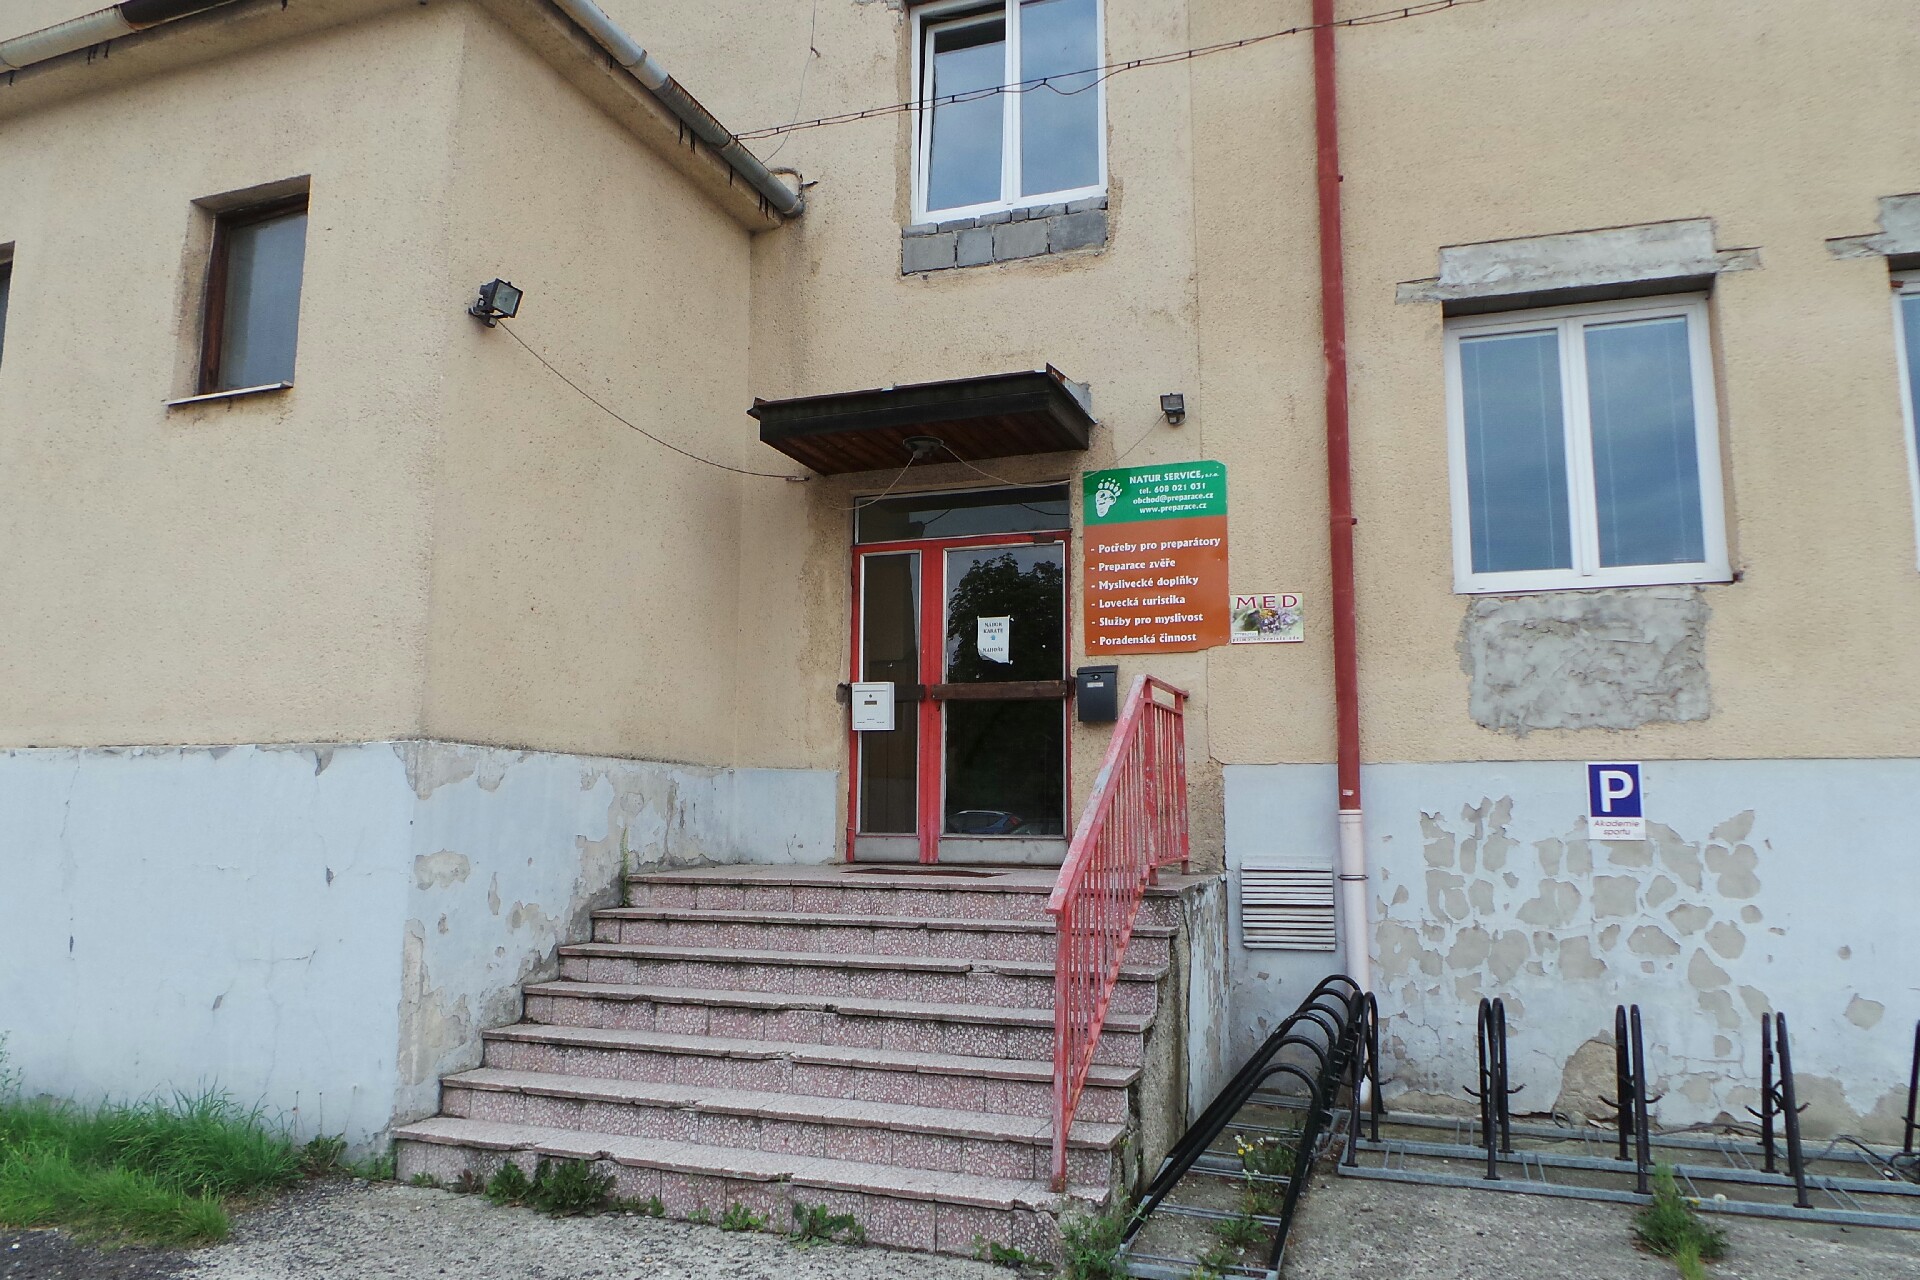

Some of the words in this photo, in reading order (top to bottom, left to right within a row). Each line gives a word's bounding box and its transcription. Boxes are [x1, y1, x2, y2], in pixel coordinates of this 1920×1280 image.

[1129, 475, 1161, 484] NATUR
[1164, 470, 1204, 481] SERVICE,
[1139, 487, 1151, 495] tel.
[1154, 485, 1169, 494] 608
[1172, 483, 1187, 492] 021
[1190, 482, 1206, 491] 031
[1133, 493, 1213, 504] obchod@preparace.cz
[1139, 503, 1207, 514] www.preparace.cz
[1098, 542, 1136, 554] Potřeby
[1140, 542, 1157, 552] pro
[1161, 537, 1220, 550] preparátory
[1098, 560, 1146, 573] Preparace
[1149, 557, 1176, 569] zvěře
[1098, 578, 1153, 590] Myslivecké
[1156, 575, 1199, 587] doplňky
[1099, 597, 1139, 609] Lovecká
[1142, 594, 1186, 605] turistika
[1236, 595, 1298, 610] MED
[1099, 616, 1131, 627] Služby
[1134, 617, 1152, 626] pro
[1155, 613, 1204, 625] myslivost
[1099, 634, 1156, 646] Poradenská
[1159, 633, 1197, 643] činnost
[1599, 770, 1634, 813] P
